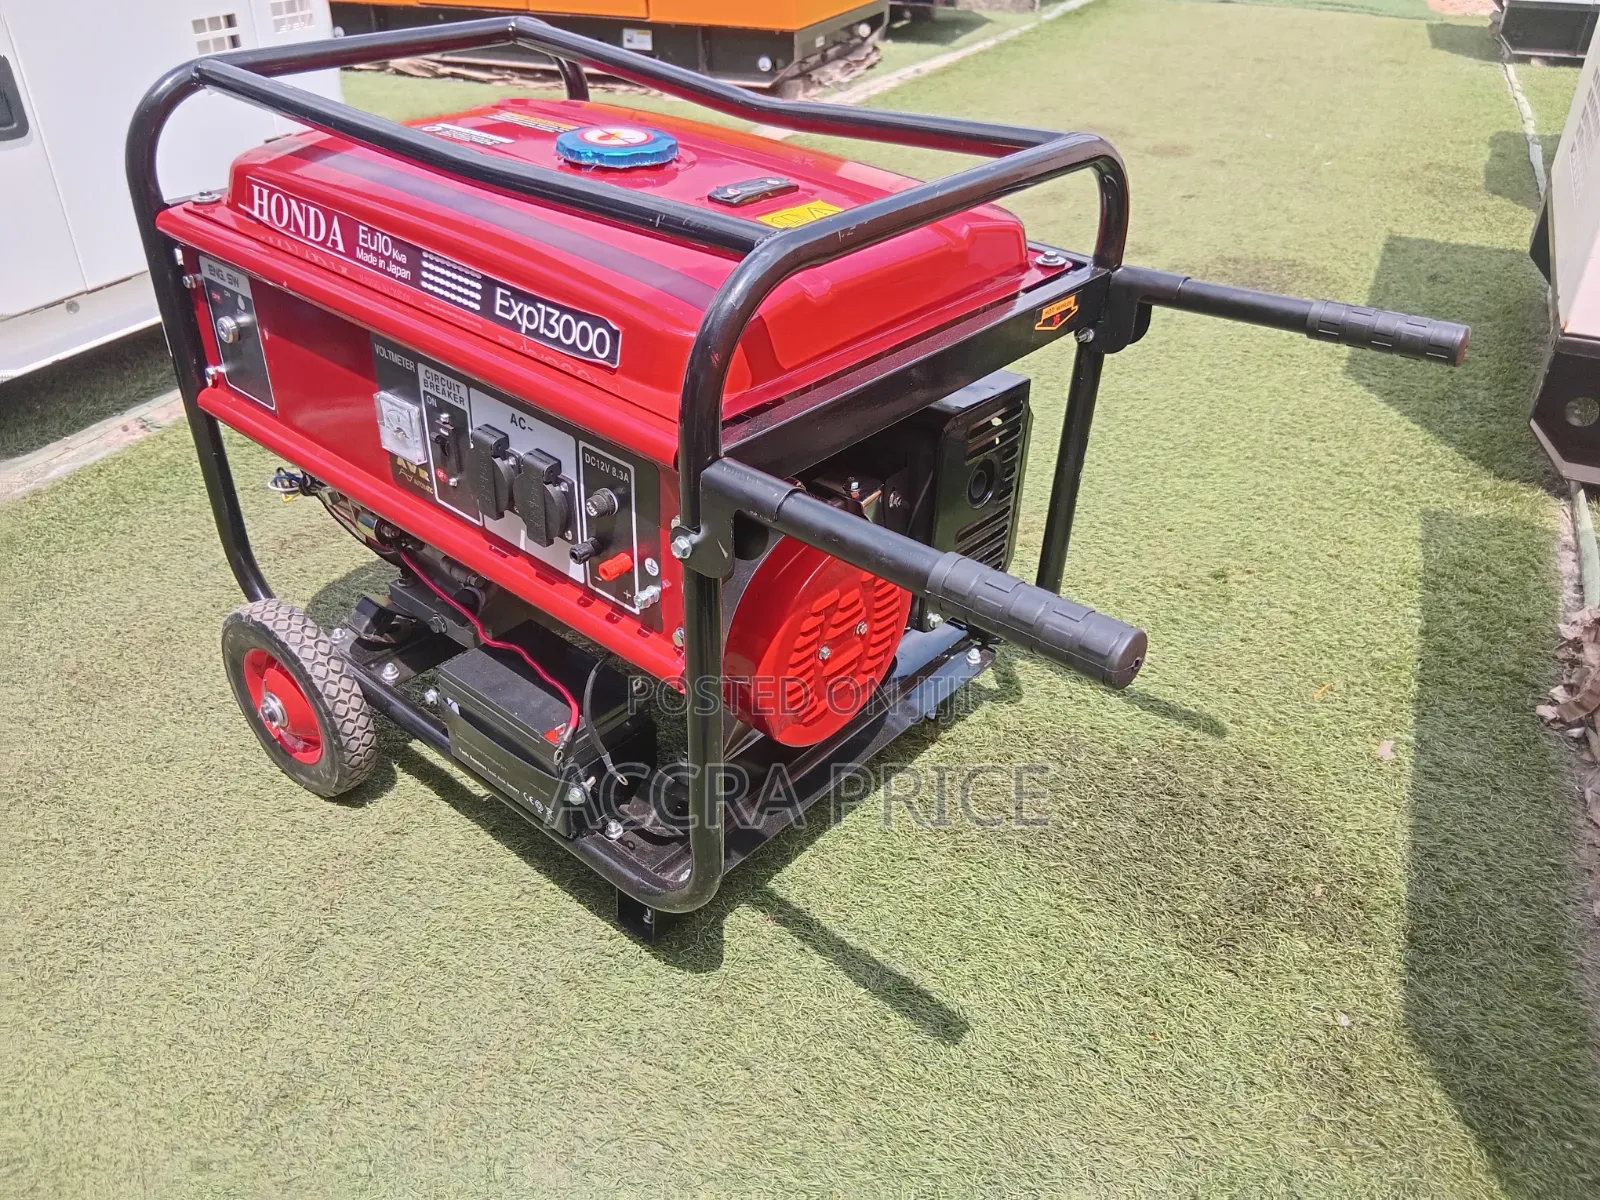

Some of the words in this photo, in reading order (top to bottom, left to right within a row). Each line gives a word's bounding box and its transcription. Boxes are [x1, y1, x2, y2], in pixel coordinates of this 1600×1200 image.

[252, 184, 346, 253] HONDA
[358, 225, 392, 257] Eu10
[356, 246, 378, 266] Made
[378, 256, 386, 270] in
[387, 260, 412, 281] Japan
[495, 287, 611, 359] Exp13000
[374, 342, 416, 373] VOLTMETER
[423, 378, 465, 406] BREAKER
[424, 369, 461, 394] CIRCUIT
[426, 394, 438, 408] ON
[584, 452, 610, 474] DC12V
[611, 466, 630, 484] 8.3A
